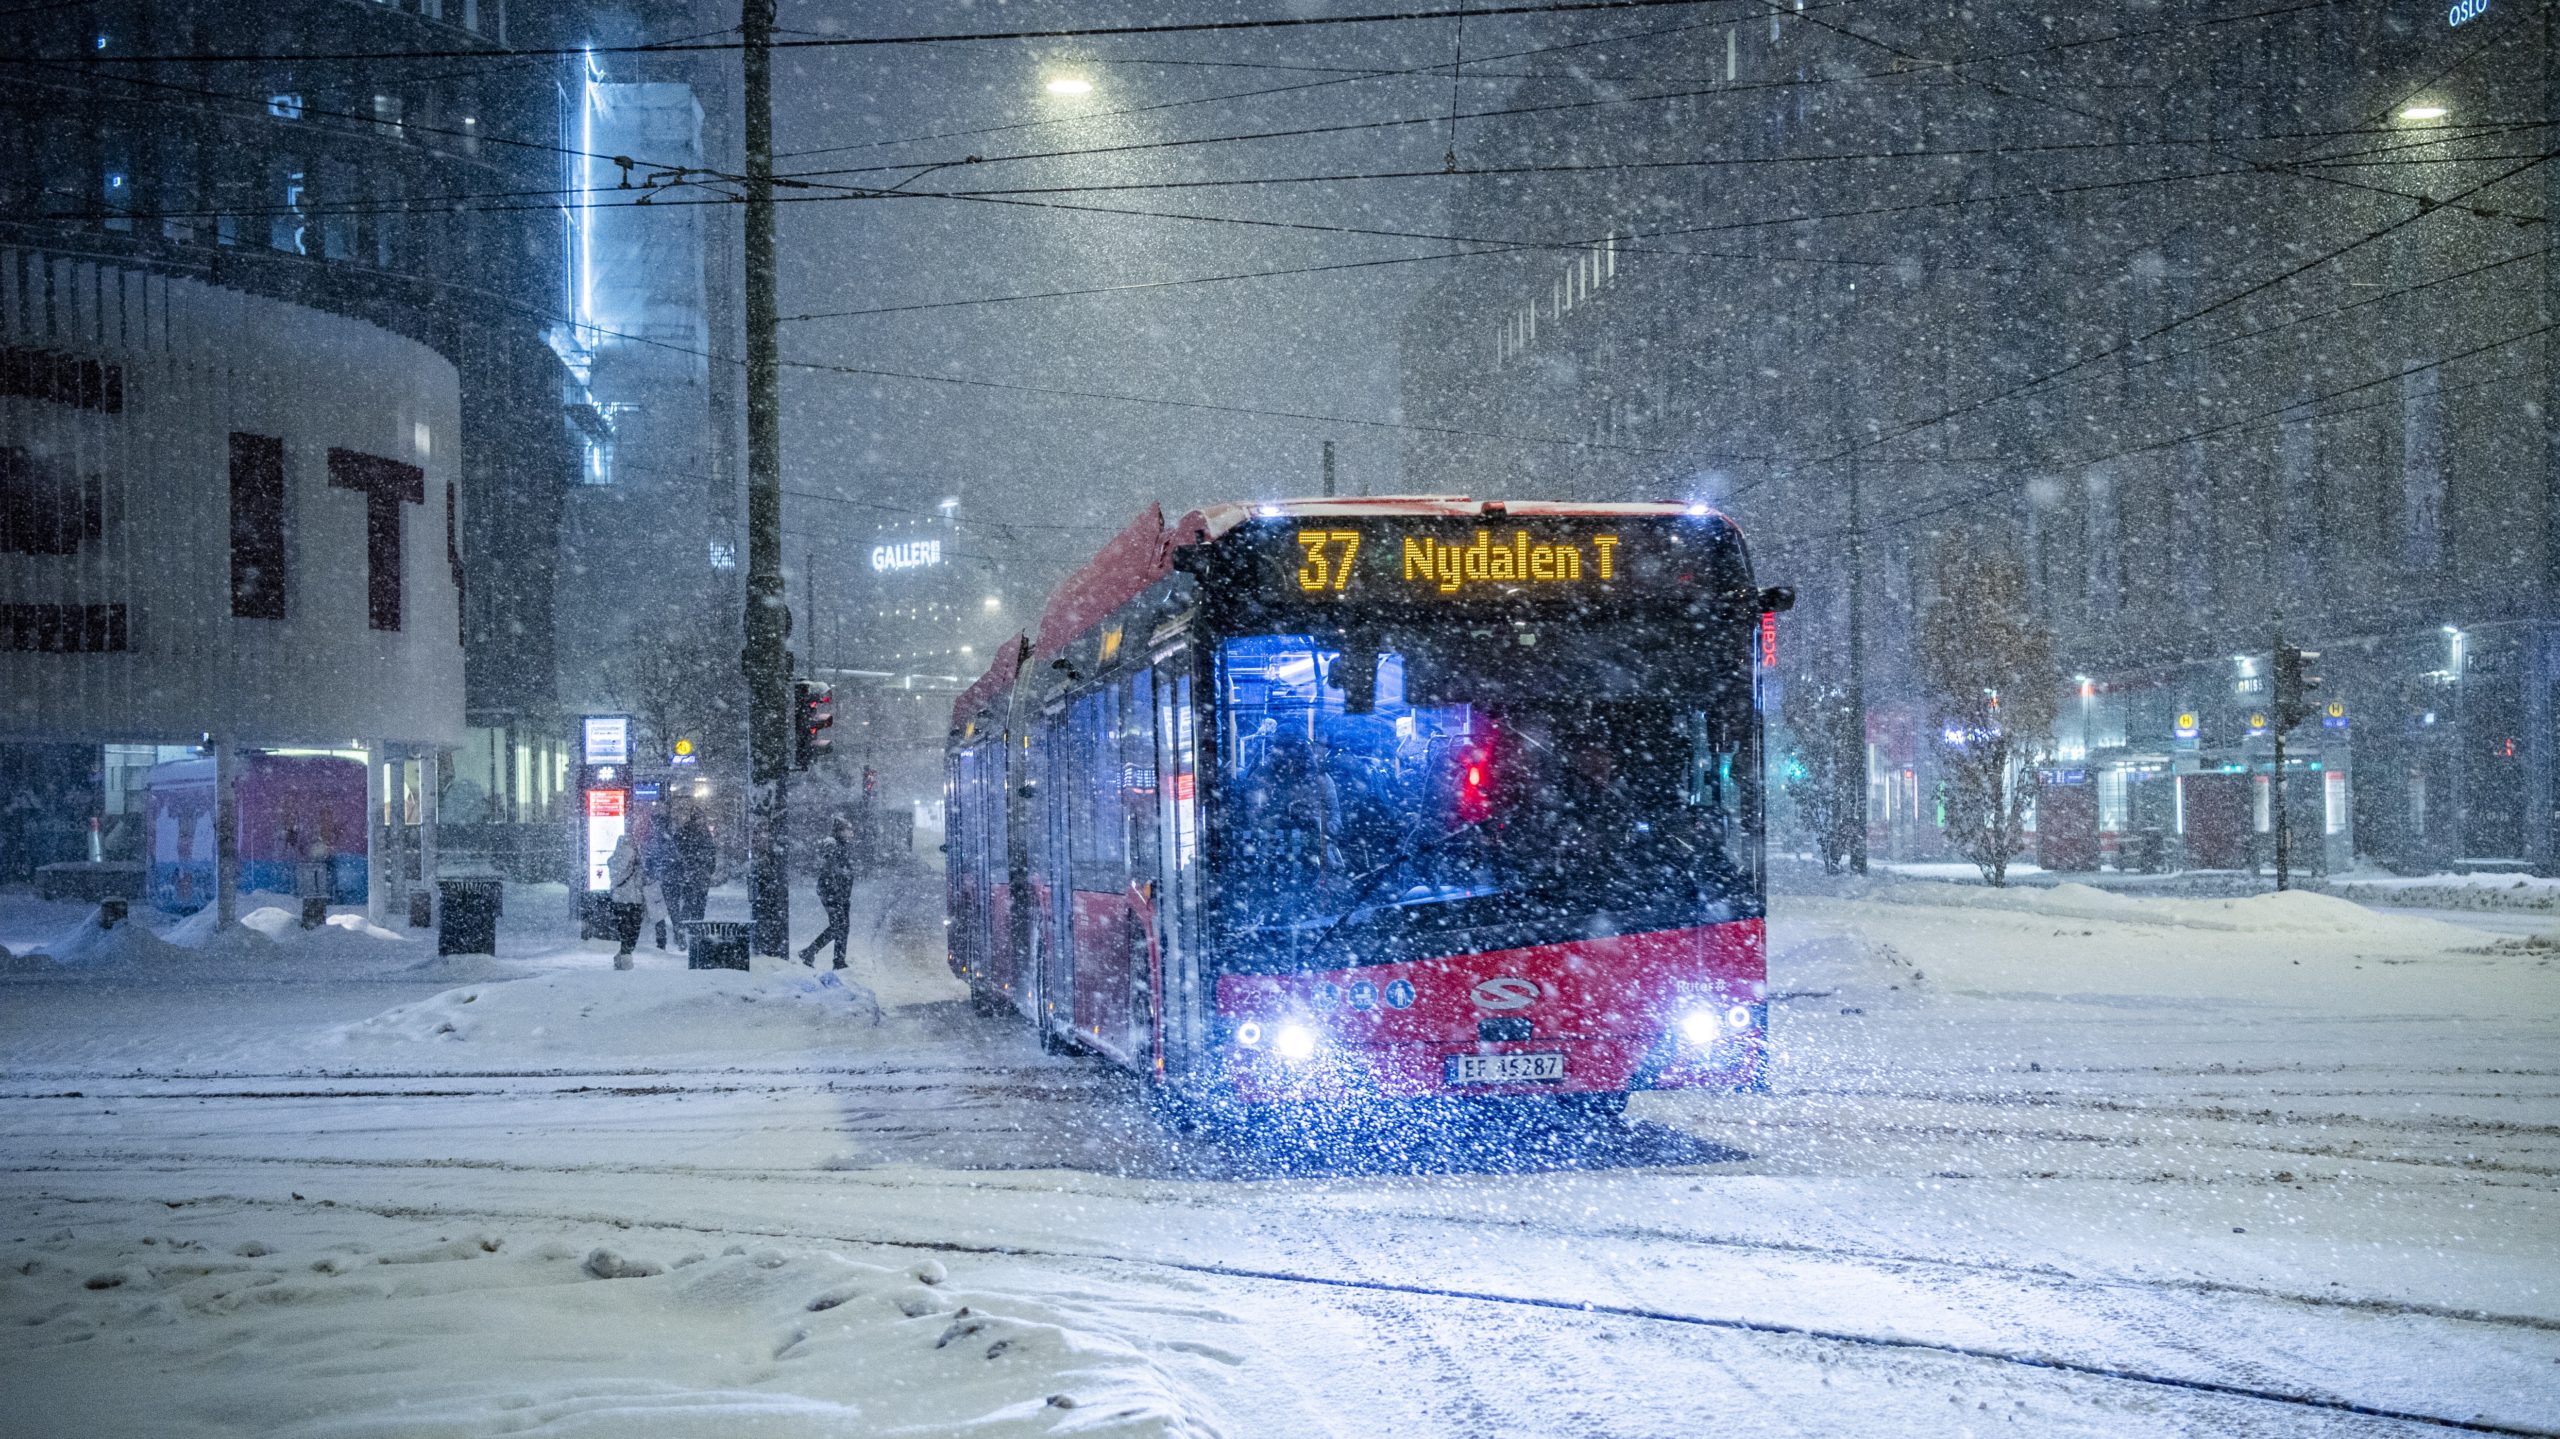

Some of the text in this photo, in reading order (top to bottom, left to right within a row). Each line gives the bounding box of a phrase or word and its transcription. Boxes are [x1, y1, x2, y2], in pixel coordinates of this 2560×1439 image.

[2449, 0, 2487, 27] OSLO
[872, 541, 936, 571] GALLERI
[1298, 530, 1618, 592] 37 Nydalen T
[1465, 1060, 1487, 1078] EF
